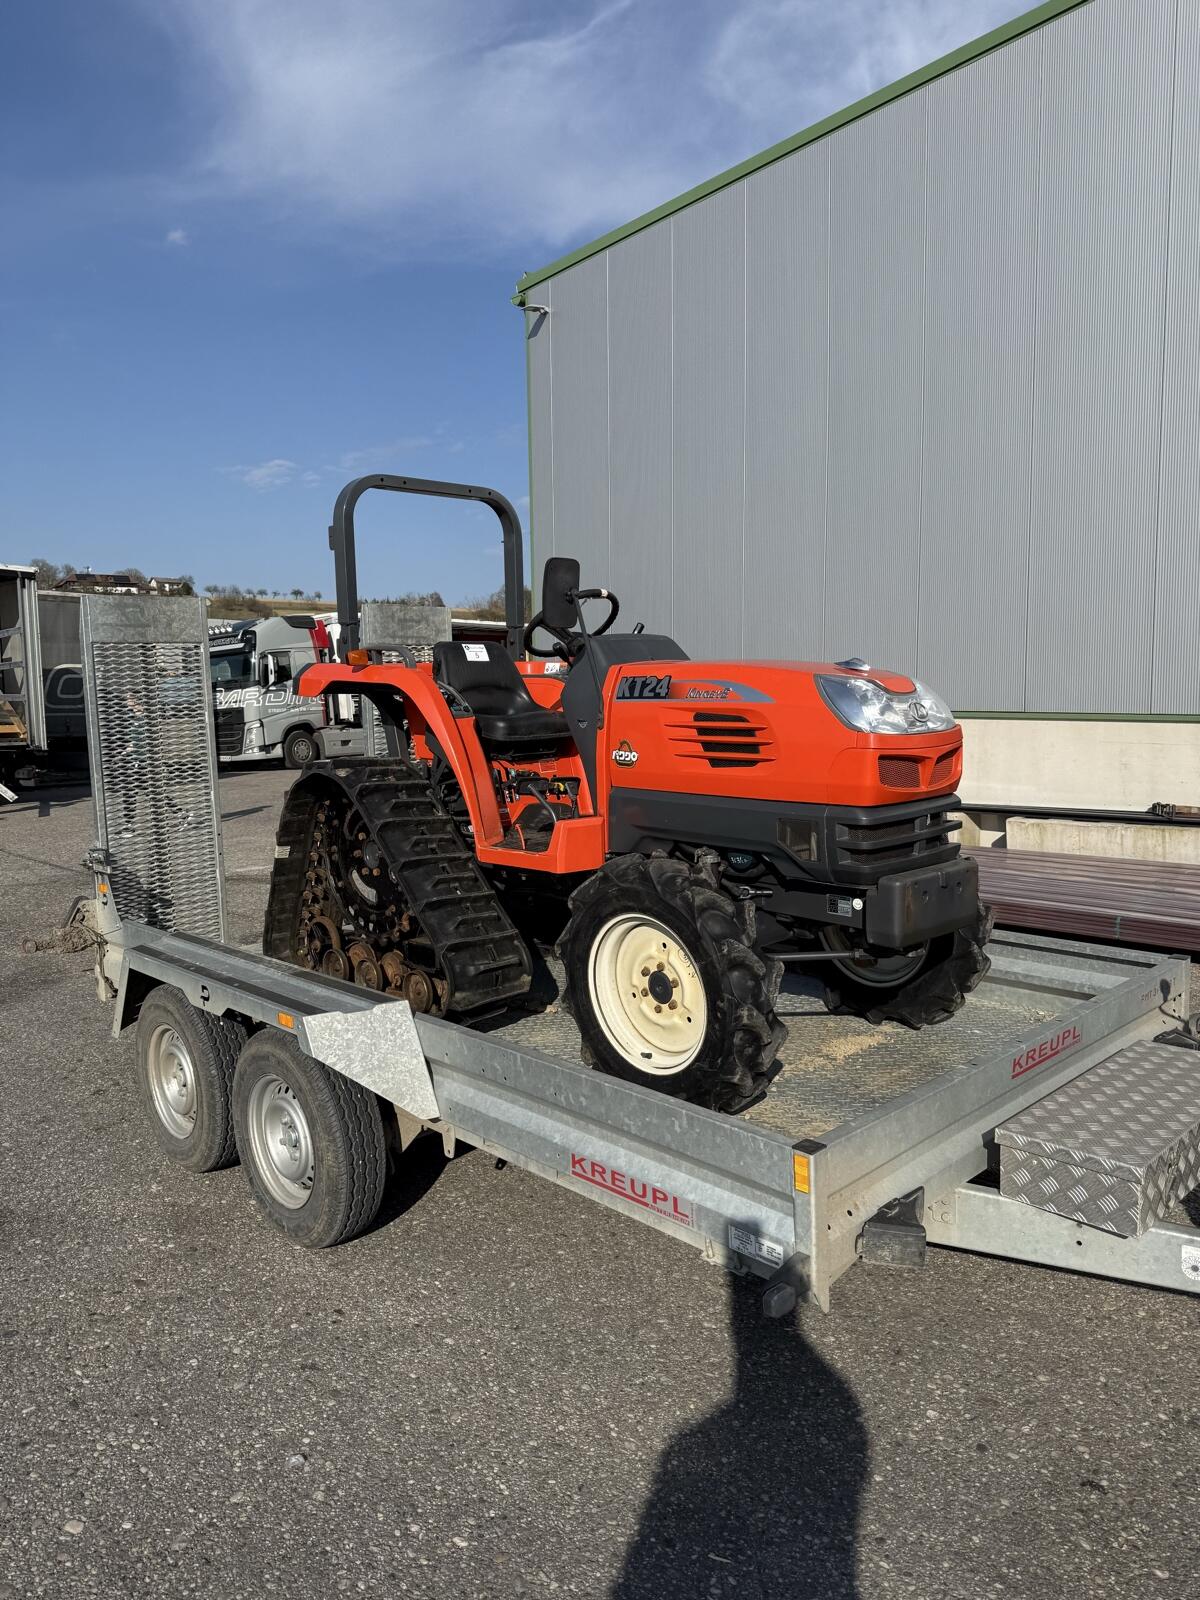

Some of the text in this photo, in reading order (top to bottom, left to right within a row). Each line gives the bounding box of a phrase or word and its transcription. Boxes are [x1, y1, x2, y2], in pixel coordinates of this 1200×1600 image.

[616, 675, 672, 699] KT24
[1011, 1025, 1081, 1074] KREUPL
[570, 1152, 690, 1219] KREUPL
